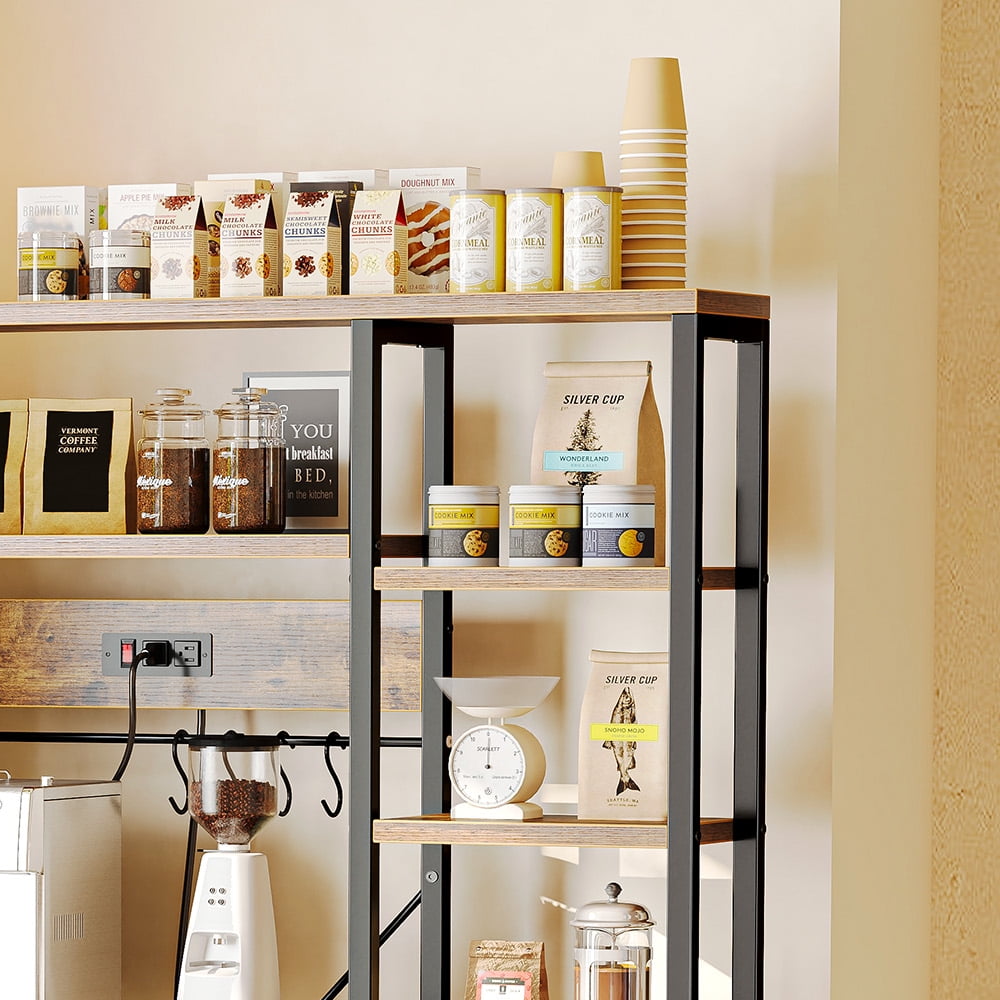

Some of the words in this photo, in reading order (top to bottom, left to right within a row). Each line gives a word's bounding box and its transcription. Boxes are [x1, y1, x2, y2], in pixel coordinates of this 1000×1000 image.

[401, 178, 440, 188] DOUGHNUT
[441, 177, 455, 187] MIX
[119, 193, 140, 203] APPLE
[141, 193, 151, 202] PIE
[23, 204, 61, 217] BROWNIE
[64, 204, 80, 217] MIX
[222, 229, 263, 237] CHUNKS
[285, 228, 327, 236] CHUNKS
[351, 226, 393, 234] CHUNKS
[152, 231, 193, 239] CHUNKS
[563, 395, 600, 405] SILVER
[602, 394, 625, 405] CUP
[61, 427, 99, 436] VERMONT
[290, 424, 333, 439] YOU
[60, 436, 98, 446] COFFEE
[58, 445, 98, 454] COMPANY
[291, 445, 333, 460] breakfast
[559, 455, 610, 463] WONDERLAND
[288, 490, 294, 499] in
[295, 490, 307, 499] the
[308, 489, 334, 499] kitchen
[434, 511, 459, 519] COOKIE
[460, 511, 475, 519] MIX
[515, 511, 541, 519] COOKIE
[541, 511, 556, 519] MIX
[615, 511, 630, 519] MIX
[605, 675, 637, 685] SILVER
[638, 675, 658, 685] CUP
